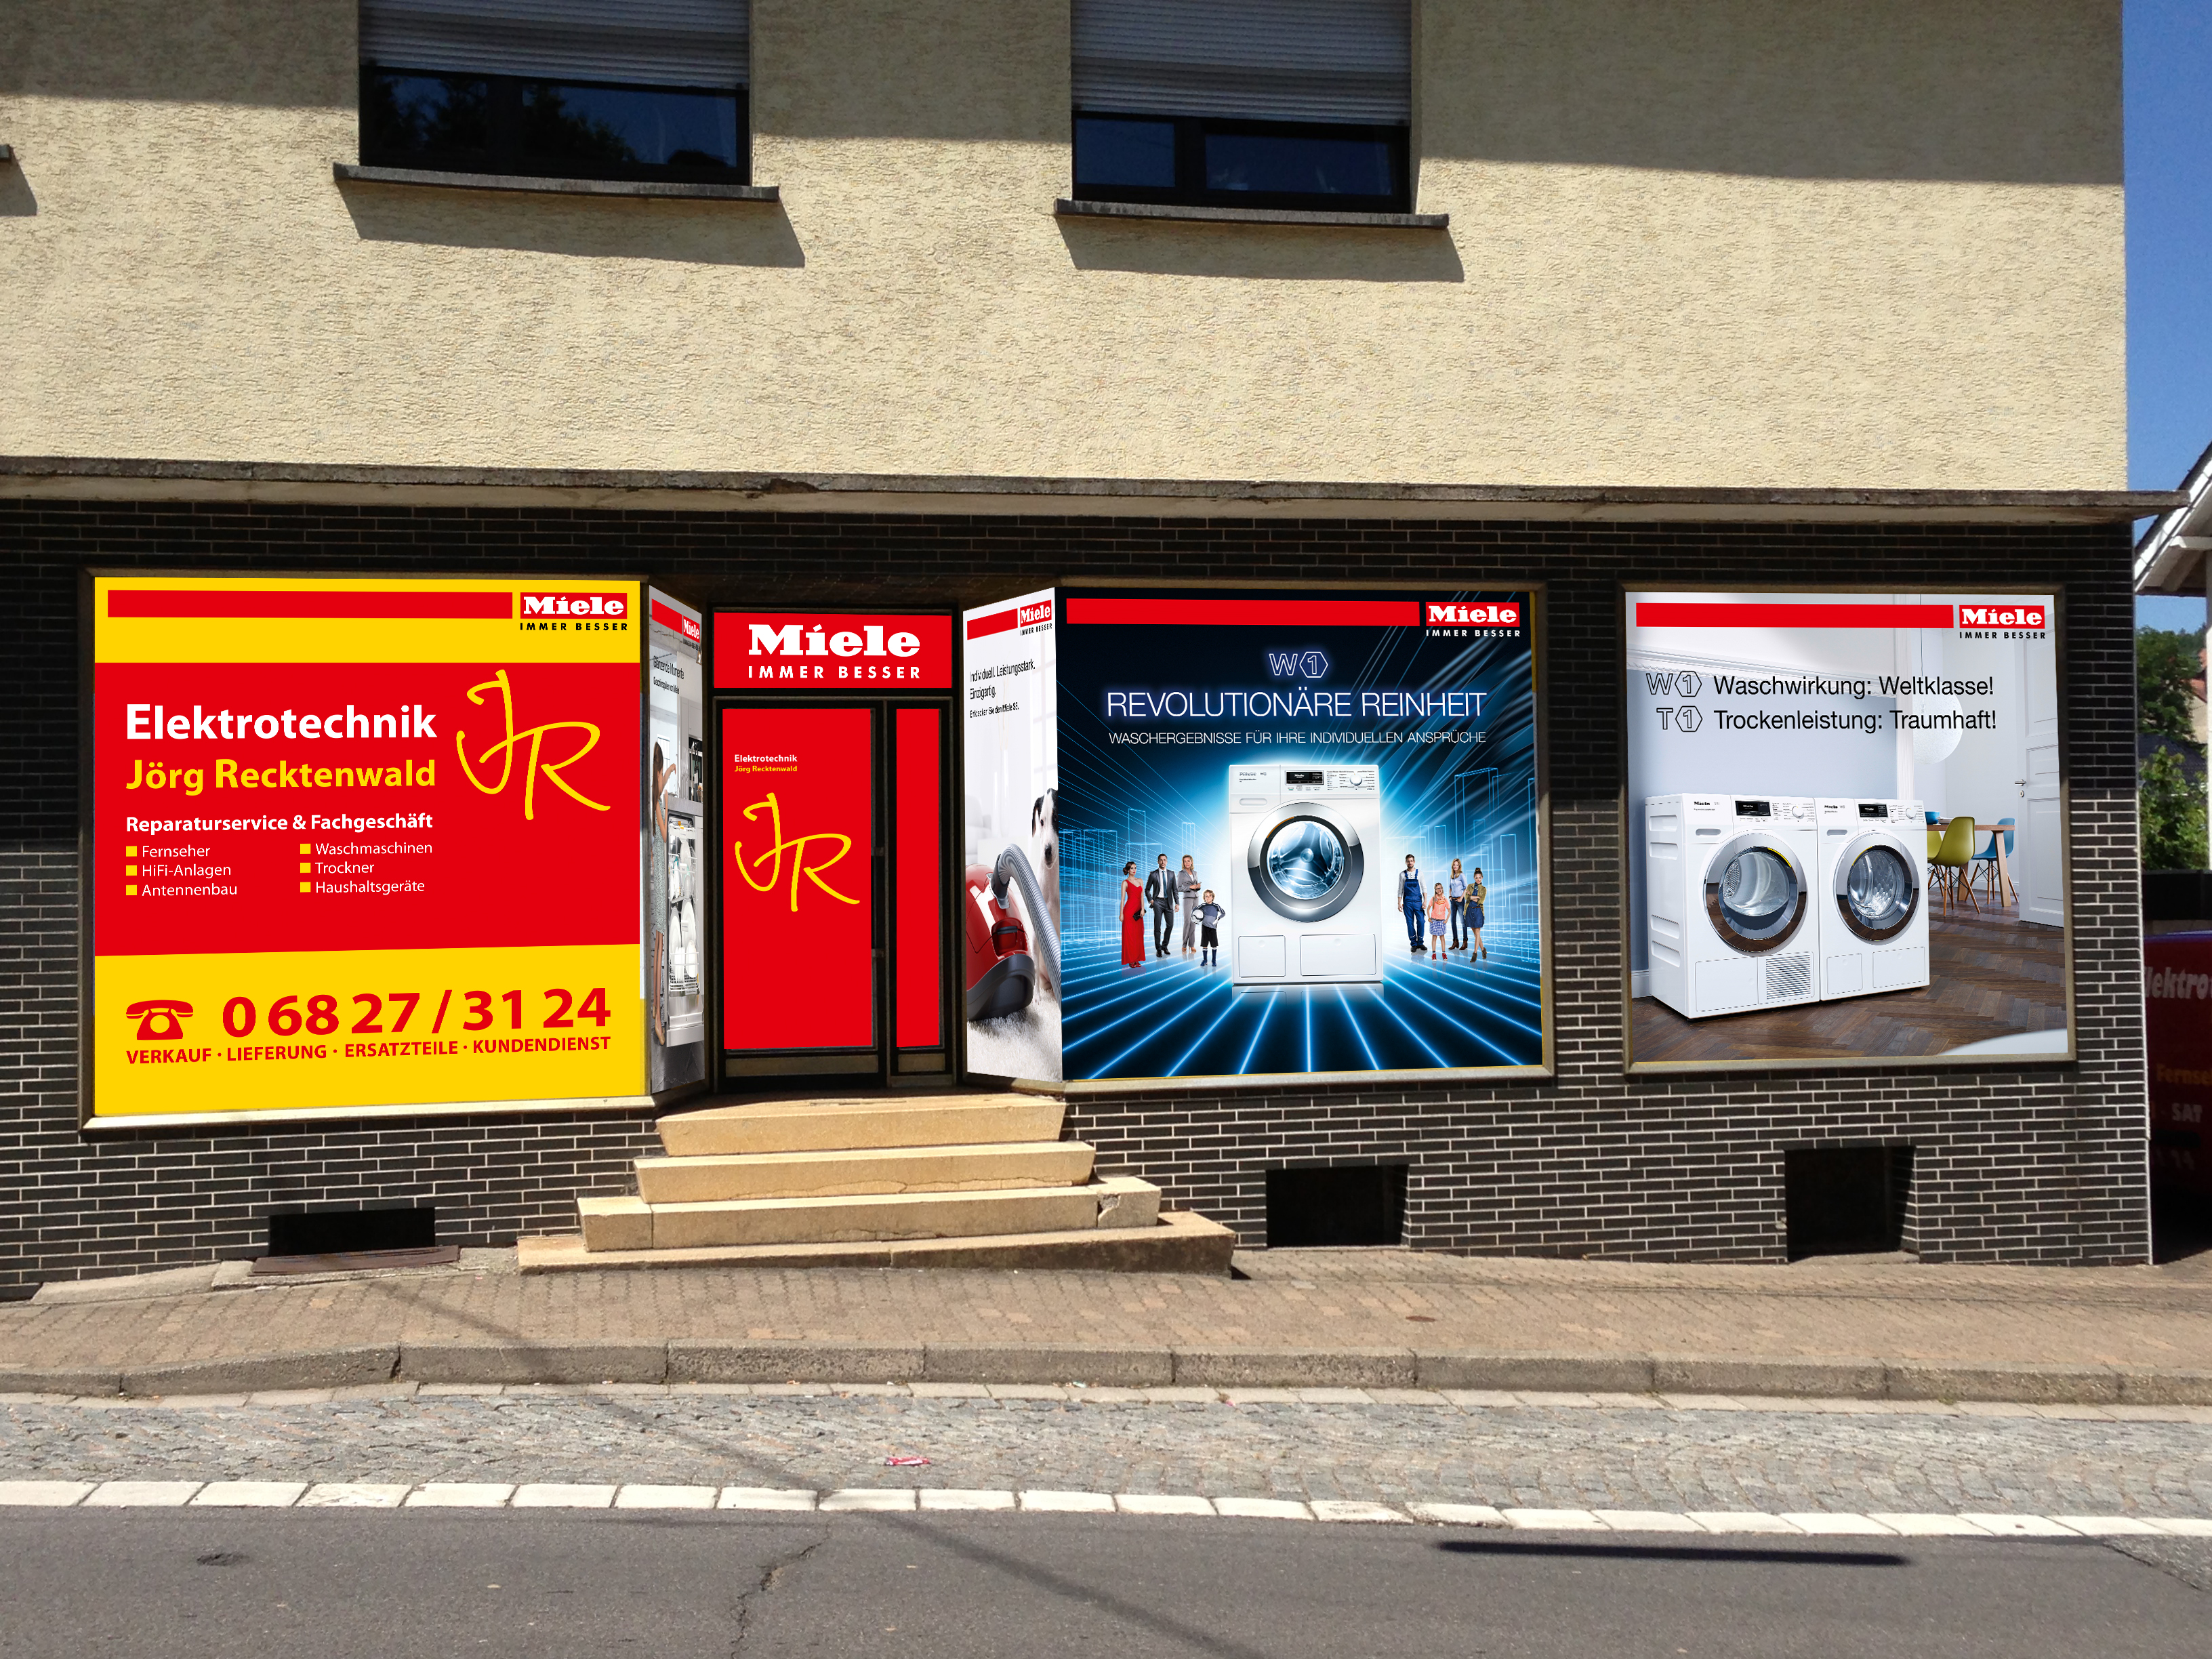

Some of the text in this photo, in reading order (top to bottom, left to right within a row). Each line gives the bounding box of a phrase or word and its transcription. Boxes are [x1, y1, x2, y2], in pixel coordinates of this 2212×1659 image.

[524, 596, 623, 615] Miele
[1020, 605, 1050, 623] Miele
[1429, 606, 1517, 623] Miele
[1962, 609, 2042, 625] Miele
[684, 619, 699, 639] Miele
[1036, 623, 1052, 632] BESSER
[749, 624, 920, 657] Miele
[749, 666, 920, 678] IMMER BESSER
[996, 658, 1036, 677] Leistungsstark.
[1714, 676, 1870, 699] Waschwirkung:
[1879, 676, 1992, 695] Weltklasse!
[1108, 687, 1487, 716] REVOLUTIONÄRE REINHEIT
[127, 704, 437, 739] Elektrotechnik
[1714, 710, 1881, 733] Trockenleistung:
[1891, 710, 1995, 729] Traumhaft!
[1109, 730, 1486, 744] WASCHERGEBNISSE FÜR IHRE INDIVIDUELLEN ANSPRÜCHE
[126, 759, 435, 796] Jörg Recktenwald
[127, 813, 432, 834] Reparaturservice & Fachgeschäft
[143, 845, 210, 857] Fernseher
[316, 842, 432, 855] Waschmaschinen
[143, 864, 230, 878] HiFi-Anlagen
[315, 861, 374, 874] Trockner
[142, 883, 237, 896] Antennenbau
[316, 880, 424, 895] Haushaltsgeräte
[2144, 966, 2212, 999] lektro
[223, 997, 255, 1037] 0
[268, 995, 339, 1036] 68
[352, 993, 419, 1033] 27
[463, 990, 521, 1030] 31
[544, 988, 611, 1028] 24
[126, 1037, 611, 1064] VERKAUF LIEFERUNG ERSATZTEILE KUNDENDIENST
[2156, 1063, 2212, 1085] Fernse
[2171, 1103, 2202, 1122] SAT
